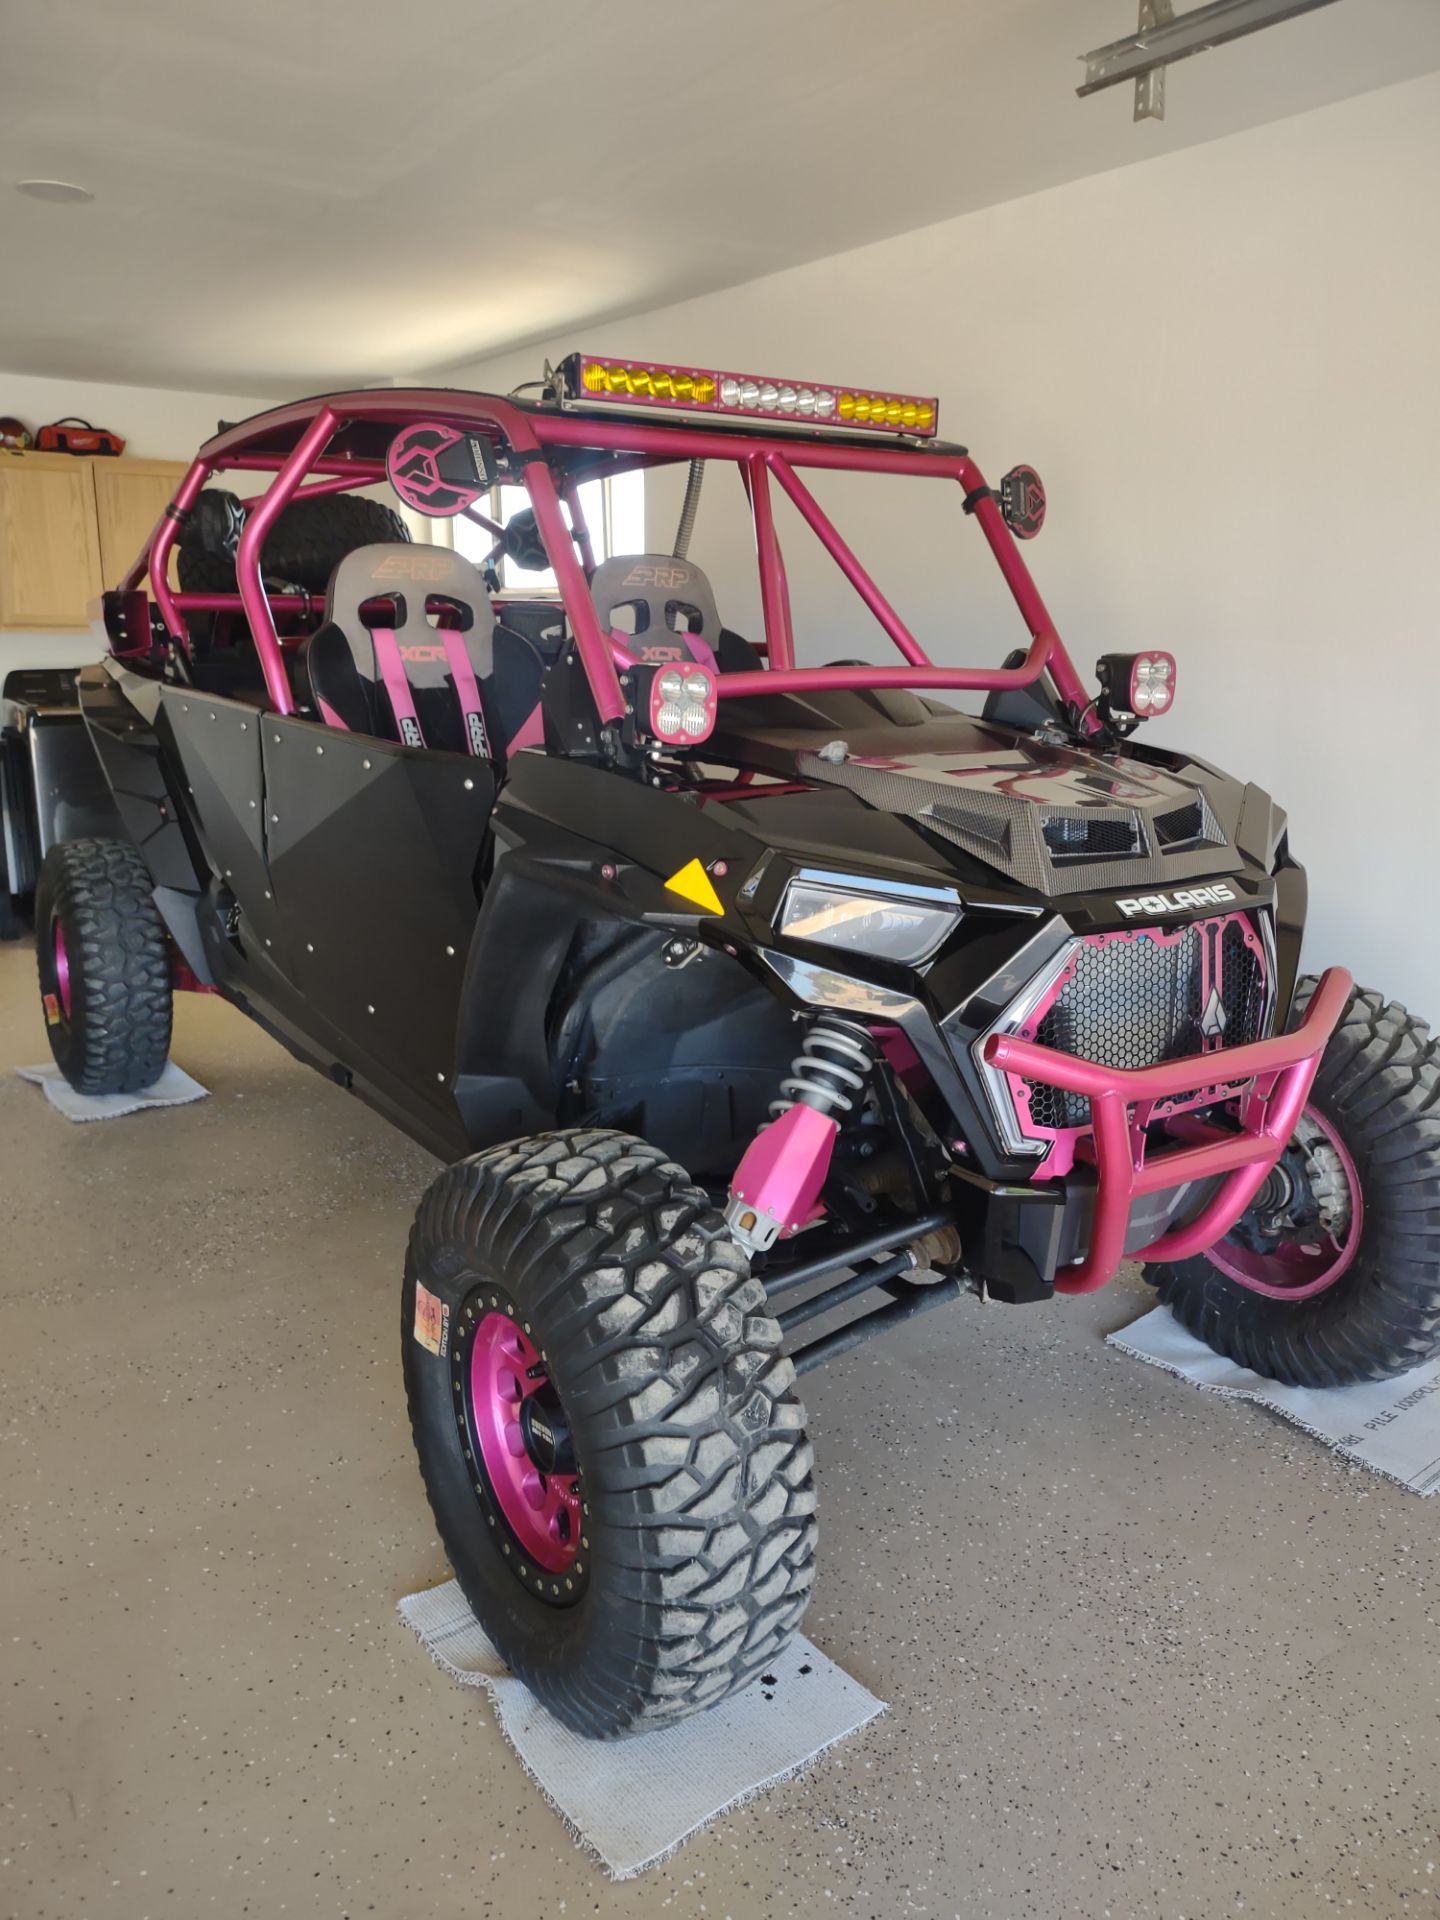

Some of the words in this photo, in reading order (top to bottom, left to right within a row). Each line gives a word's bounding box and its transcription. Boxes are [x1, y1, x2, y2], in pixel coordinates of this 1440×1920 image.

[641, 647, 682, 661] XCR
[1114, 883, 1237, 919] POLARIS
[1362, 1410, 1399, 1432] PILE
